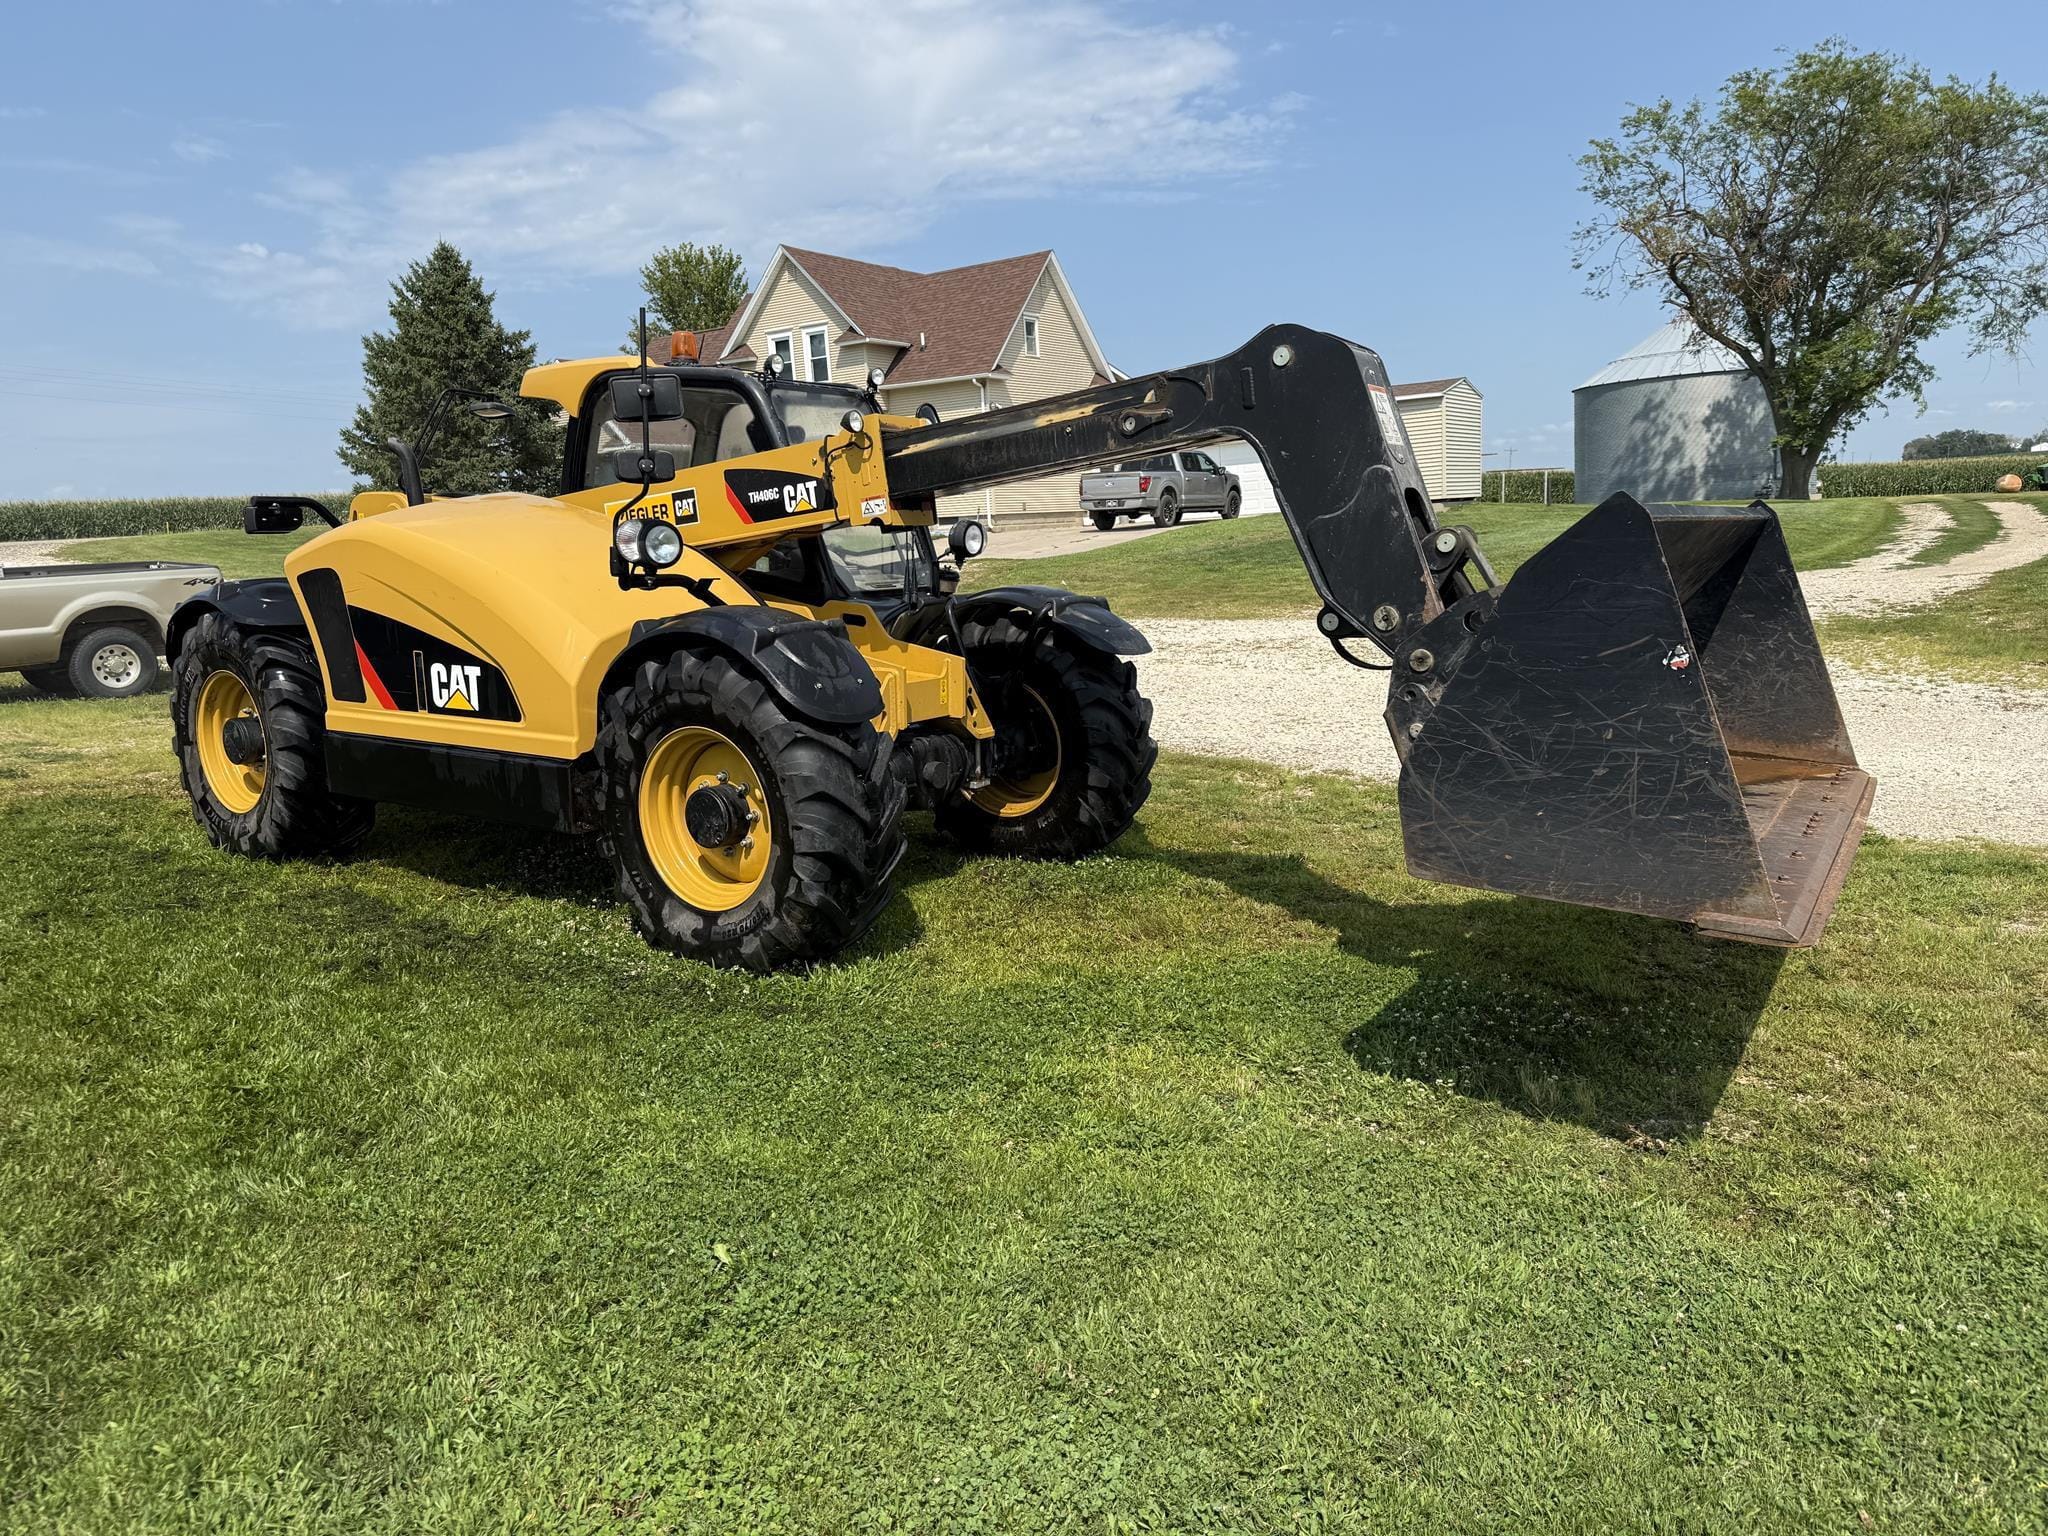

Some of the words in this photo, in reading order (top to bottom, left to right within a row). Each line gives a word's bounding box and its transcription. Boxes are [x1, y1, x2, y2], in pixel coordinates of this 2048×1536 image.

[674, 498, 695, 517] CAT
[747, 487, 780, 504] TH406C
[783, 480, 818, 513] CAT
[430, 662, 481, 712] CAT
